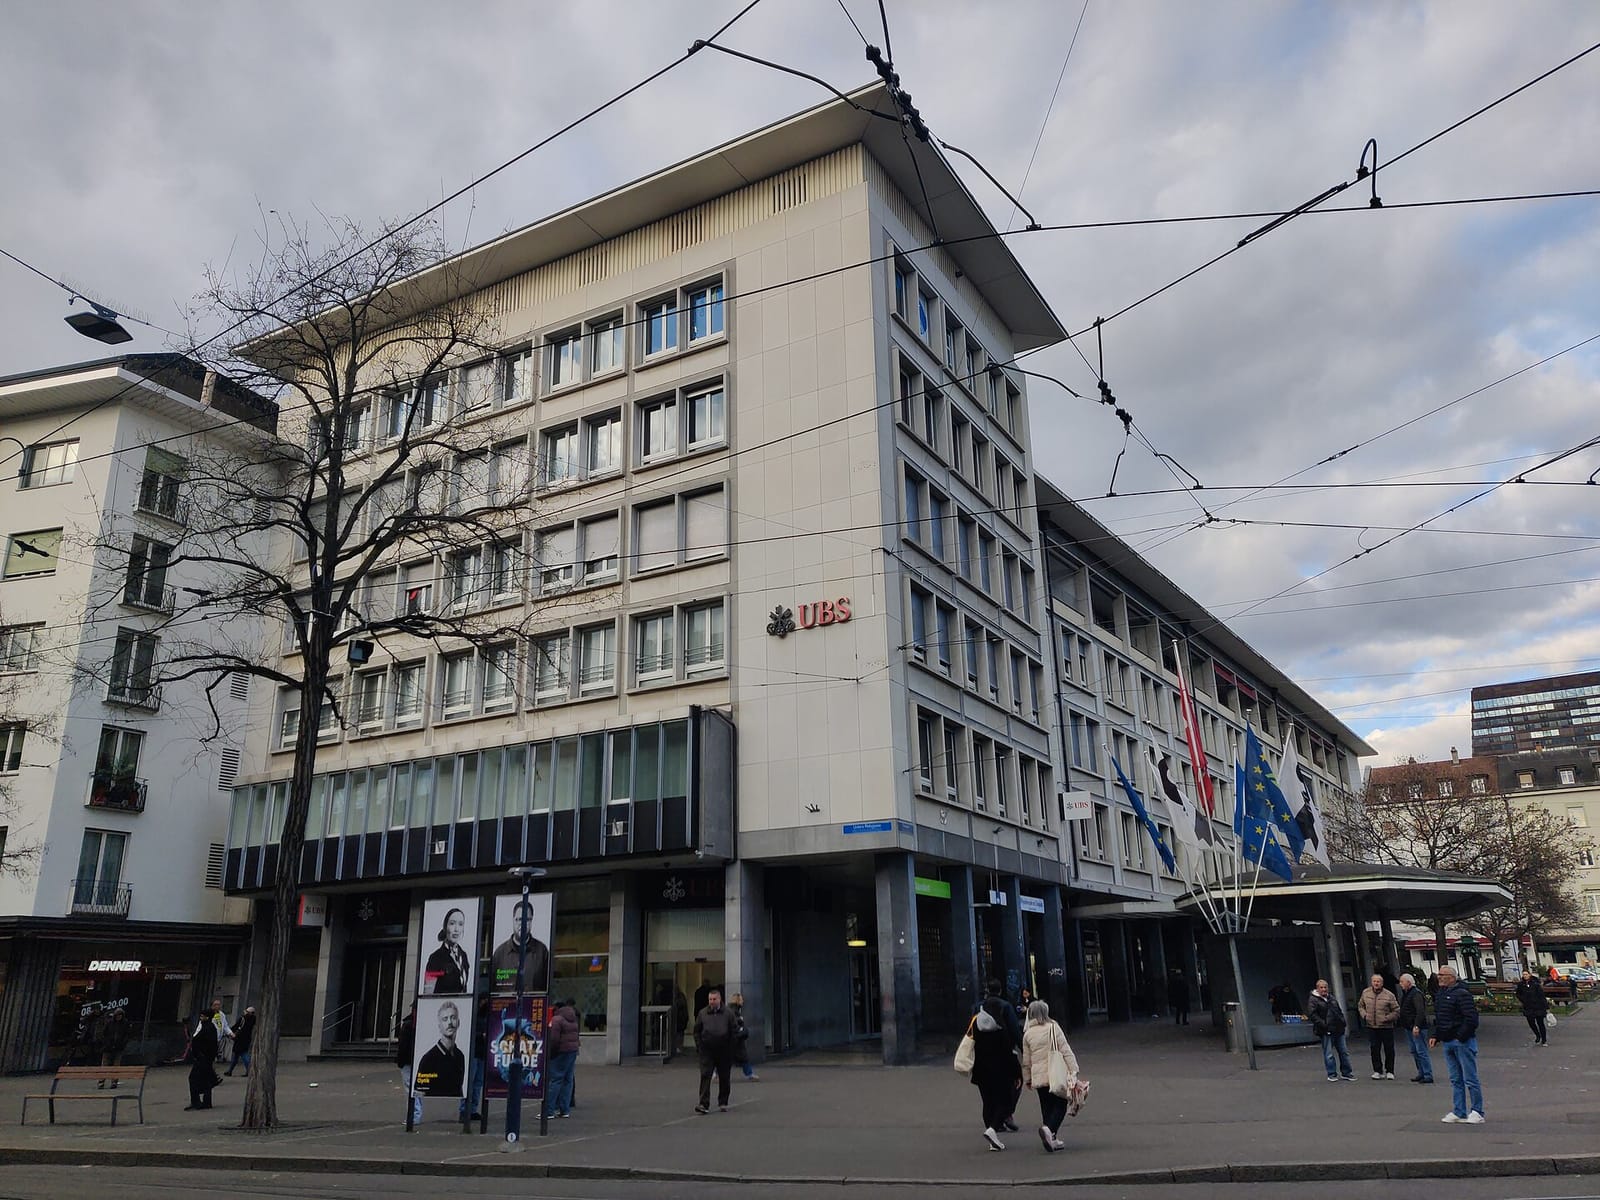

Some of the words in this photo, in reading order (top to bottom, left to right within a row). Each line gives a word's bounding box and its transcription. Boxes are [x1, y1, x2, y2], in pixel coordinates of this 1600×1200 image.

[798, 597, 851, 629] UBS
[1074, 801, 1089, 809] UBS
[88, 960, 142, 972] DENNER
[493, 1053, 539, 1068] FUDE
